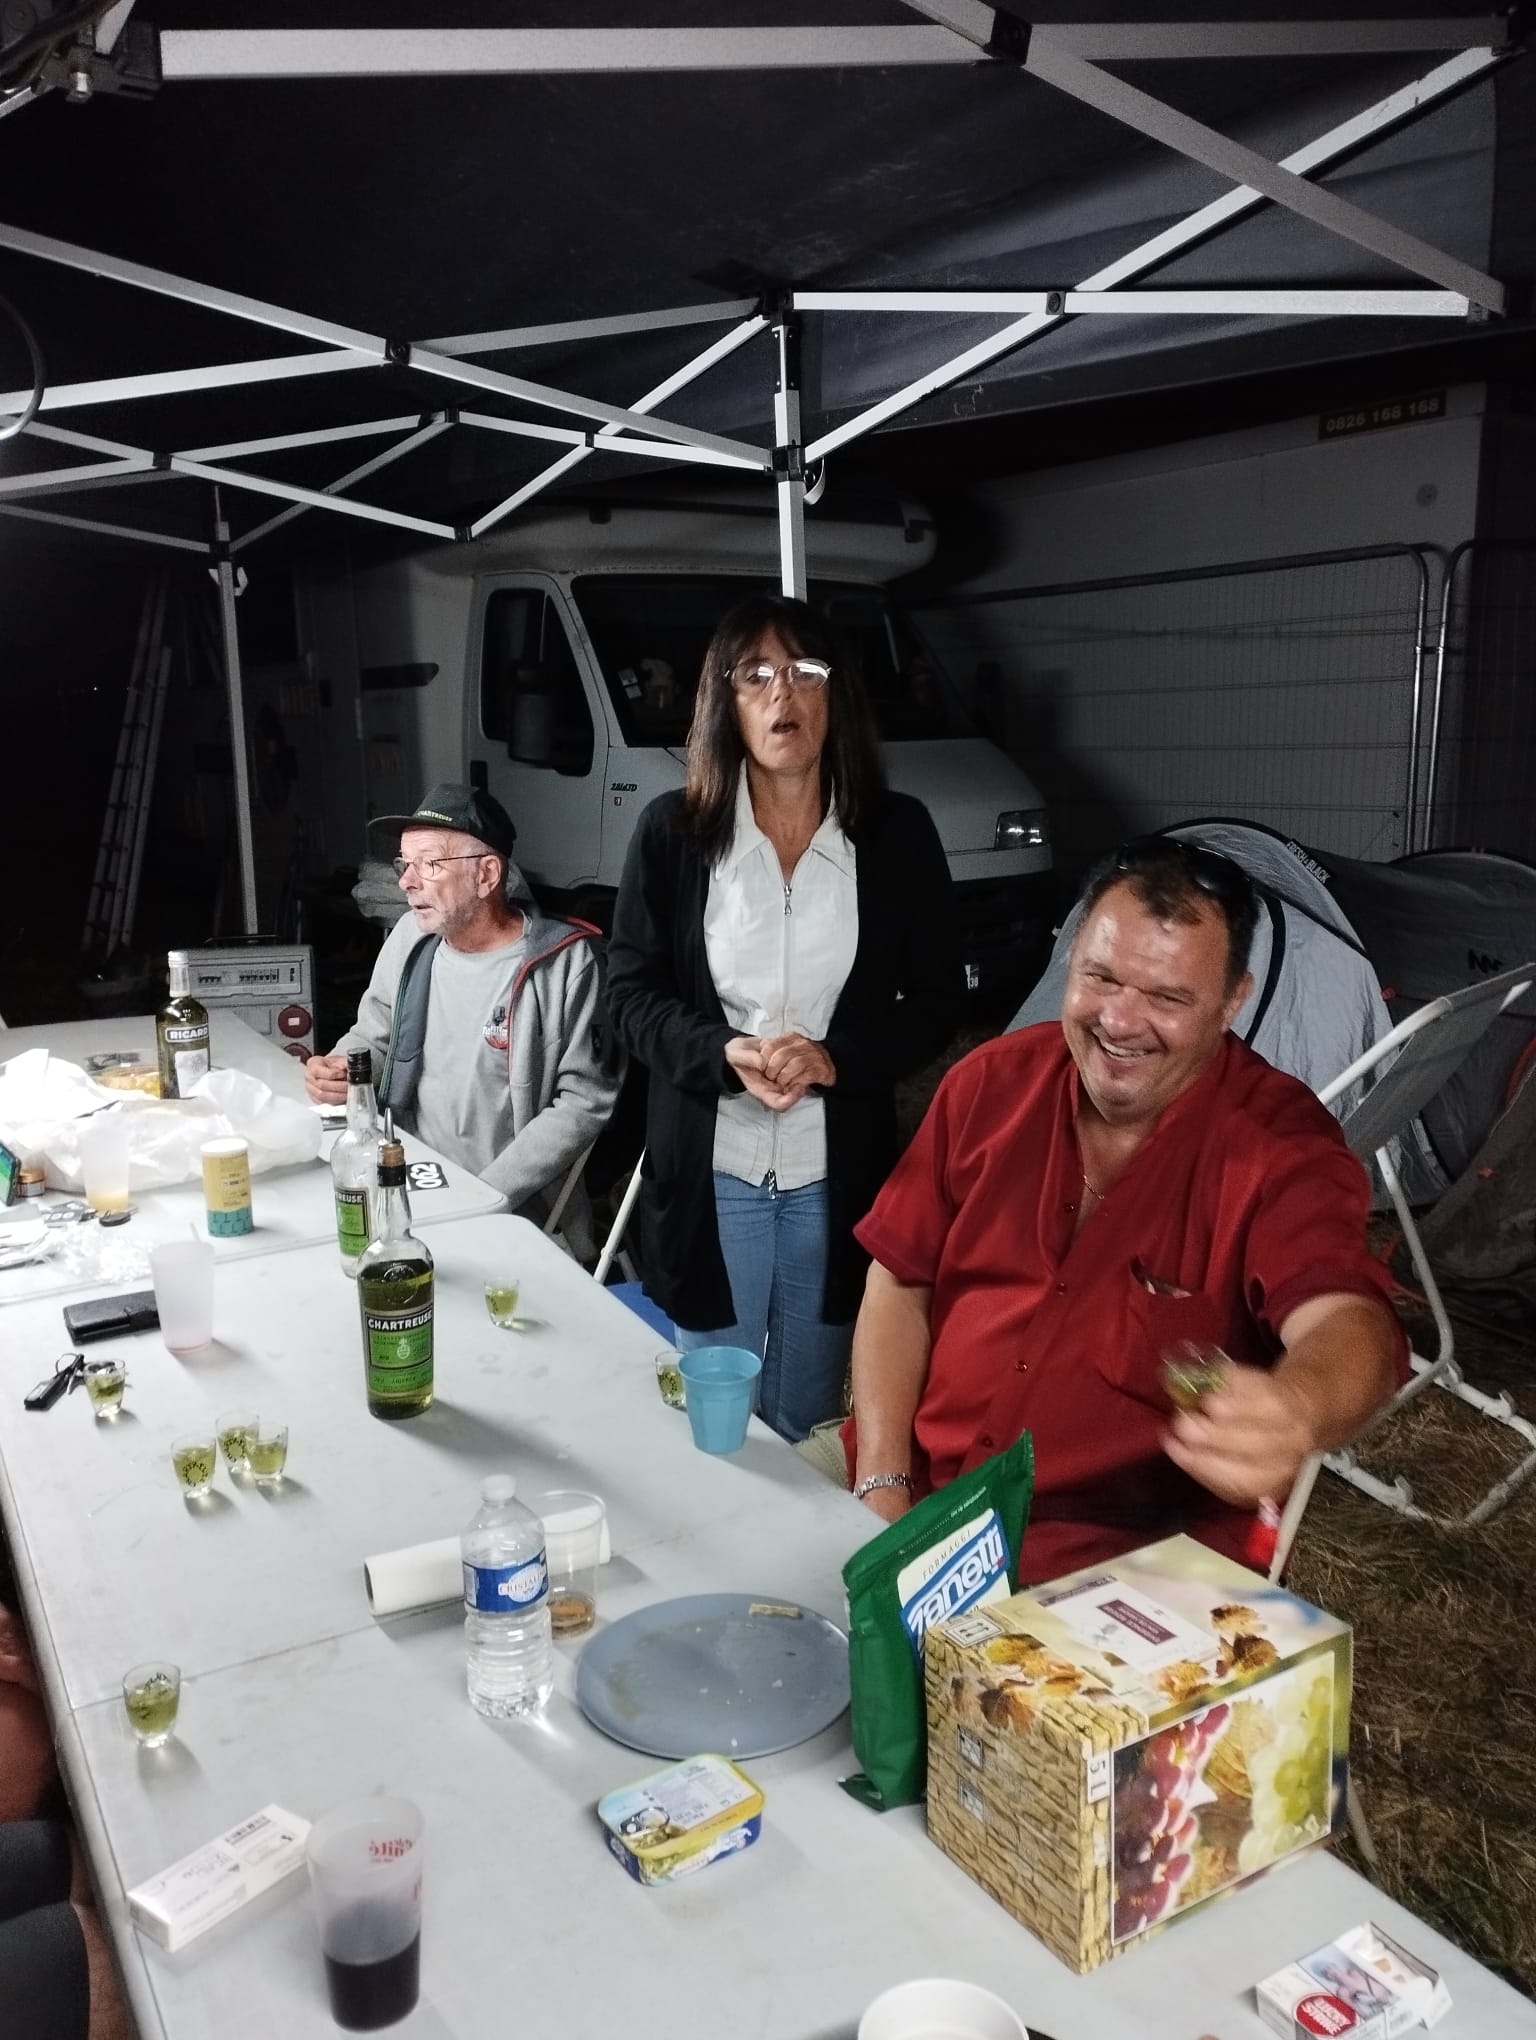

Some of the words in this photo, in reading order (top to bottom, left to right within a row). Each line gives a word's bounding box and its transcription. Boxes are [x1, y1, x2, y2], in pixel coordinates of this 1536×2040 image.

[169, 1026, 208, 1040] RICARD
[410, 1163, 443, 1189] 062
[367, 1309, 433, 1331] CHARTREUSE
[922, 1527, 972, 1580] FORMAGGI
